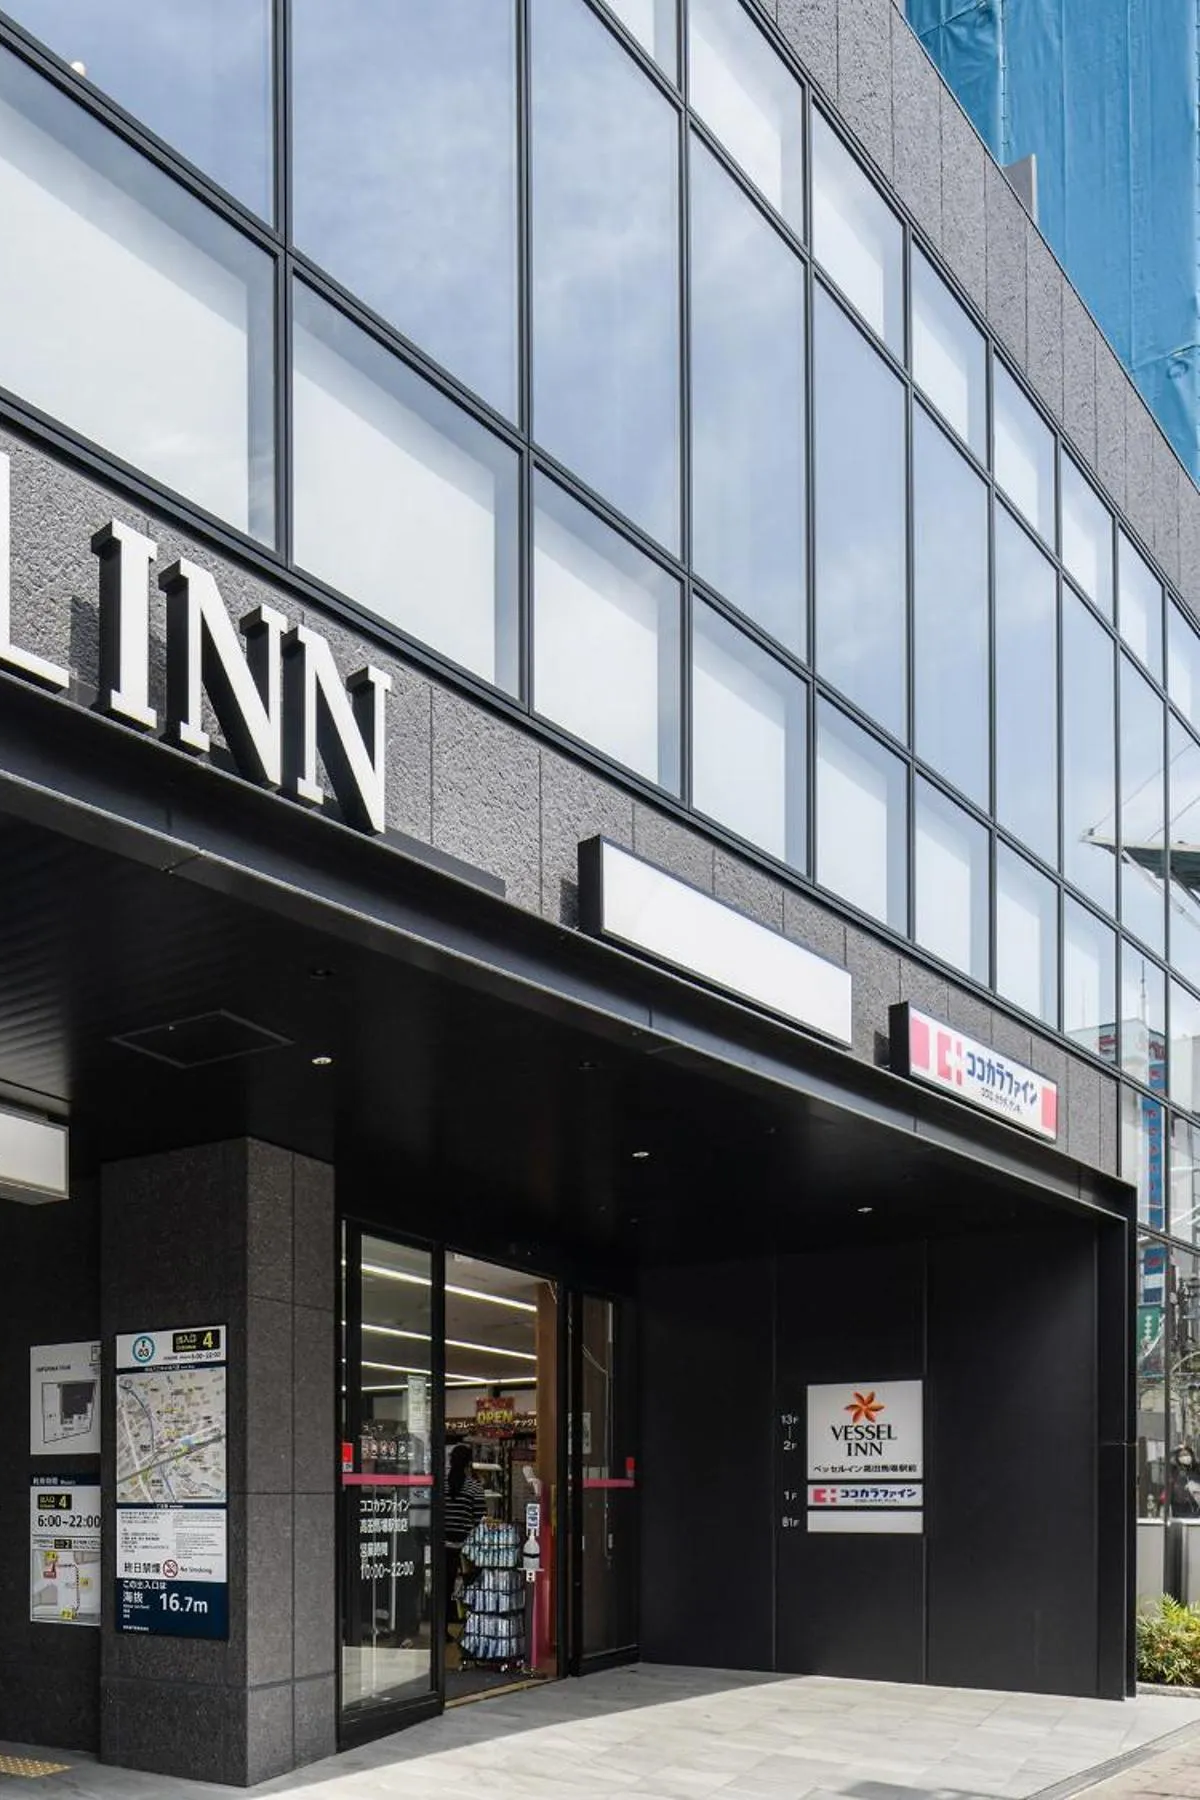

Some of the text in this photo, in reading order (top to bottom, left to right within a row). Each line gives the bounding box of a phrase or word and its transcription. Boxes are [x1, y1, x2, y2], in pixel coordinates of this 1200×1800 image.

[93, 519, 391, 834] INN
[966, 1051, 1038, 1107] ココカラファイン
[202, 1331, 214, 1349] 4
[477, 1410, 513, 1425] OPEN
[781, 1414, 799, 1425] 13F
[831, 1423, 898, 1441] VESSEL
[783, 1440, 798, 1451] 2F
[846, 1442, 883, 1457] INN
[784, 1491, 798, 1501] 1F
[840, 1488, 917, 1499] ココカラファイン
[58, 1495, 68, 1509] 4
[159, 1593, 208, 1614] 16.7m
